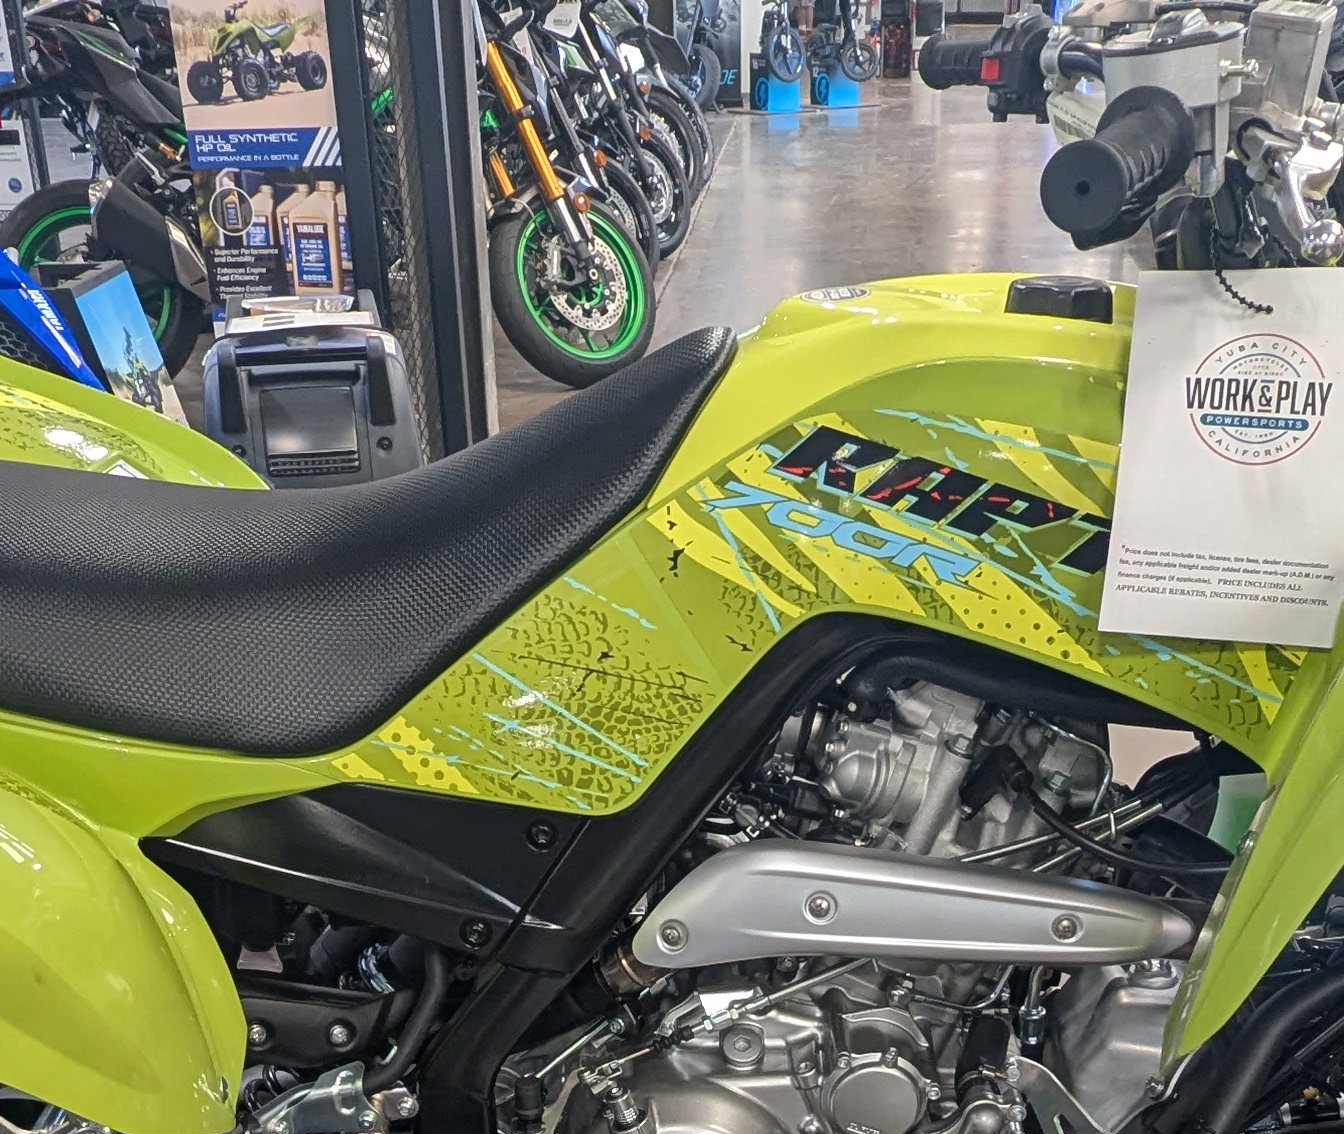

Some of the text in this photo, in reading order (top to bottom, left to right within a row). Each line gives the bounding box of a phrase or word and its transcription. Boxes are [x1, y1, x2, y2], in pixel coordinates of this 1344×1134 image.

[195, 133, 298, 144] FULL SYNTHETIC
[197, 143, 236, 153] HP OIL
[214, 249, 239, 257] Superior
[1215, 341, 1308, 366] YUBA CITY
[1206, 415, 1304, 430] POWERSPORTS
[1208, 430, 1301, 459] CALIFORNIA
[766, 424, 1113, 577] RAPT
[703, 480, 994, 598] 700R
[1144, 560, 1177, 569] applicable
[1178, 562, 1199, 571] freight
[1262, 569, 1288, 578] mark-up
[1171, 551, 1194, 559] include
[1261, 558, 1281, 567] dealer
[1282, 560, 1329, 569] documentation
[1117, 571, 1140, 579] finance
[1142, 573, 1167, 582] charges
[1217, 578, 1243, 587] PRICE
[1244, 580, 1286, 590] INCLUDES
[1286, 583, 1303, 592] ALL
[1116, 584, 1329, 607] APPLICABLE REBATES, INCENTIVES AND DISCOUNTS.
